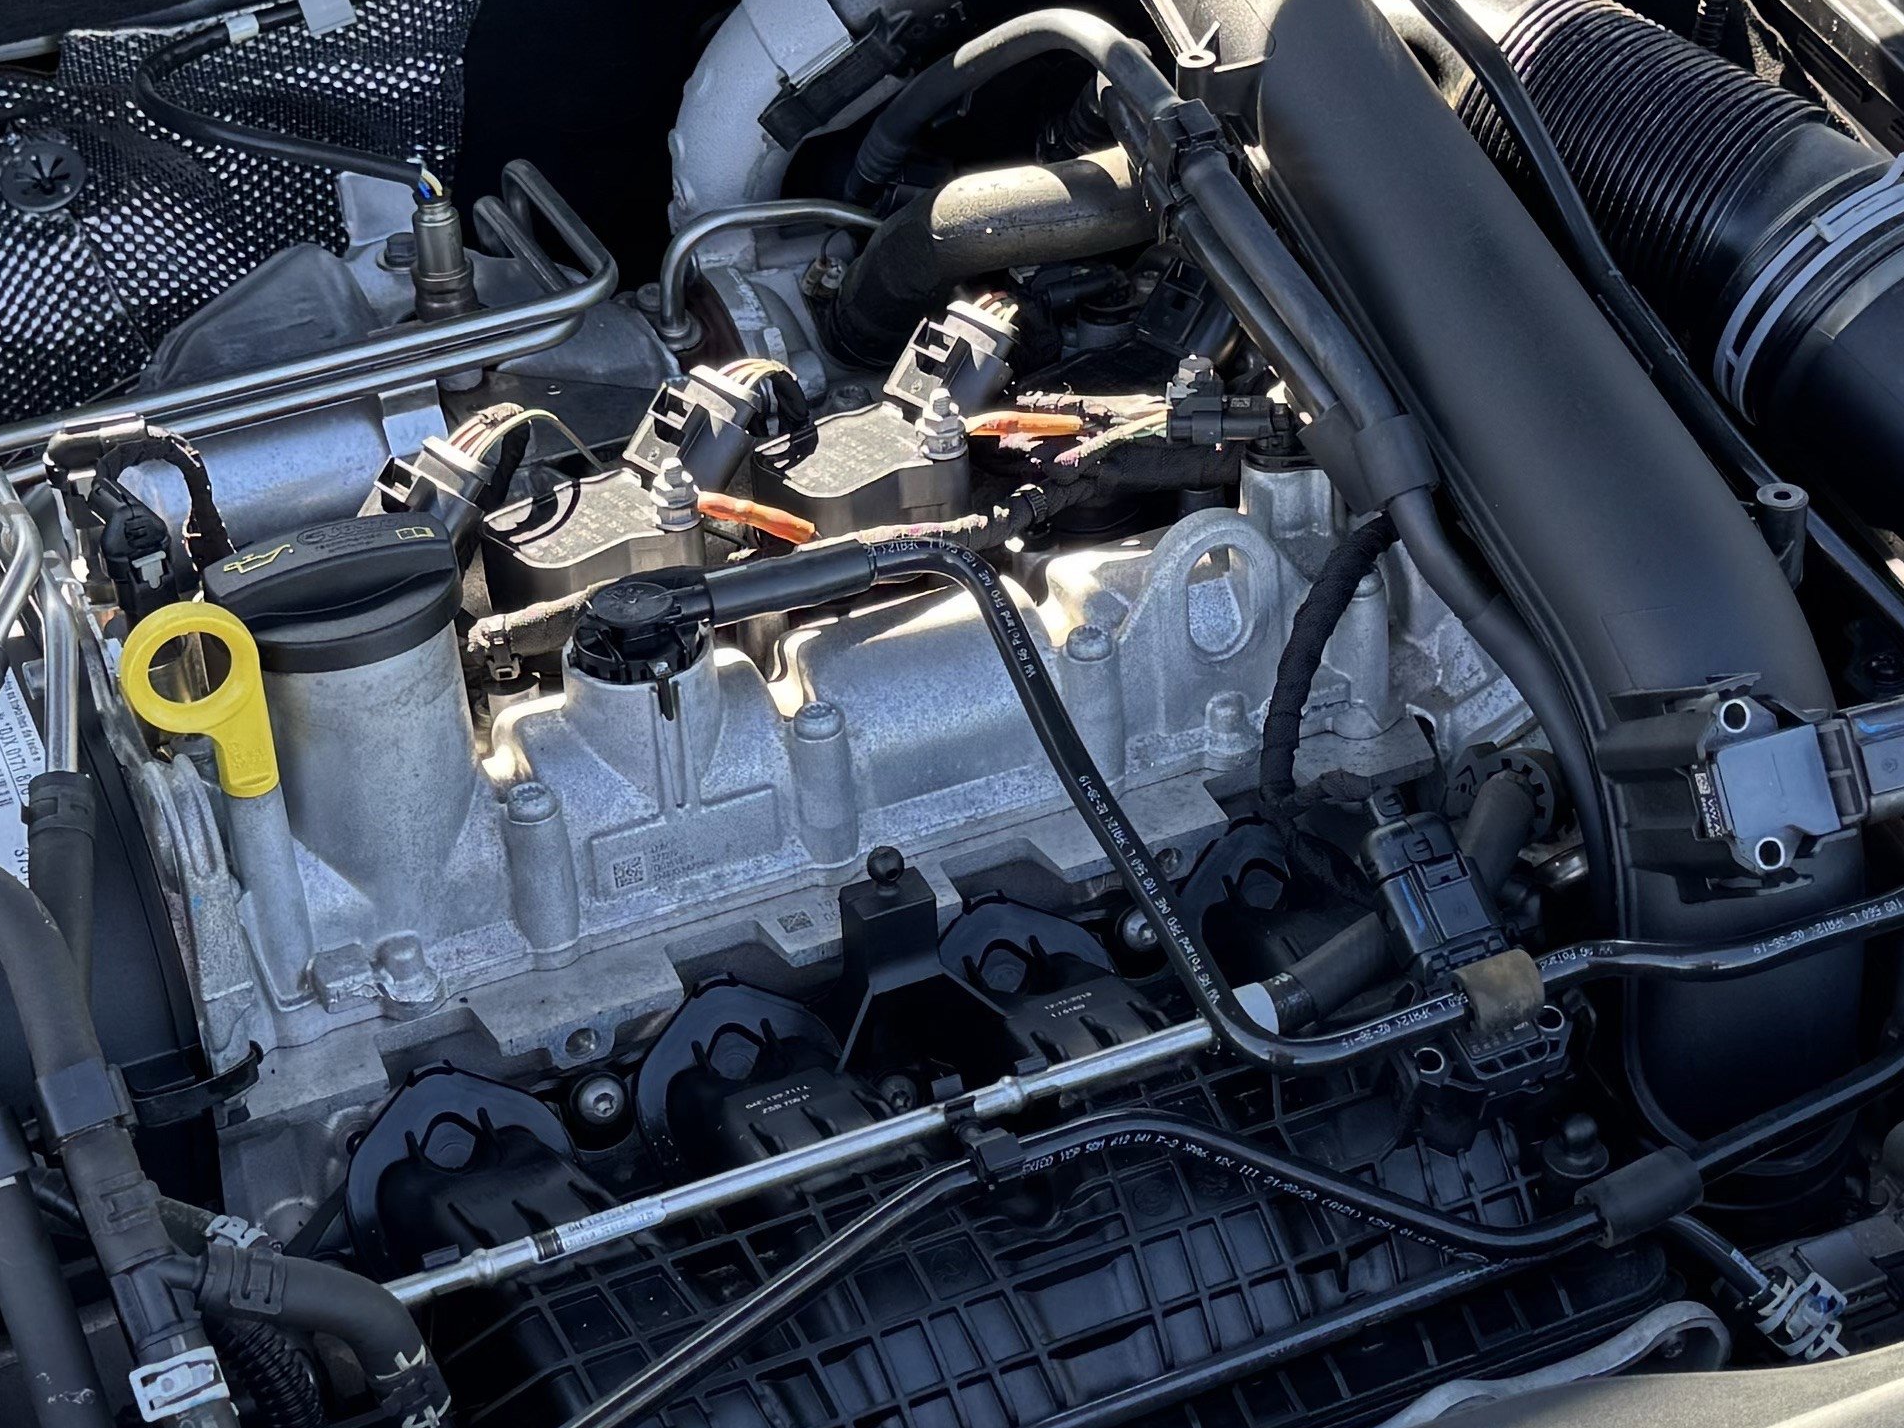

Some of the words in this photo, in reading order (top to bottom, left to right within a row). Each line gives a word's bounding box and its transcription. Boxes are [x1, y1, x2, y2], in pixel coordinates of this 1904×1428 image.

[1000, 609, 1022, 646] Poland
[4, 745, 28, 773] 0171
[1177, 936, 1204, 972] Poland
[1538, 948, 1577, 971] Poland
